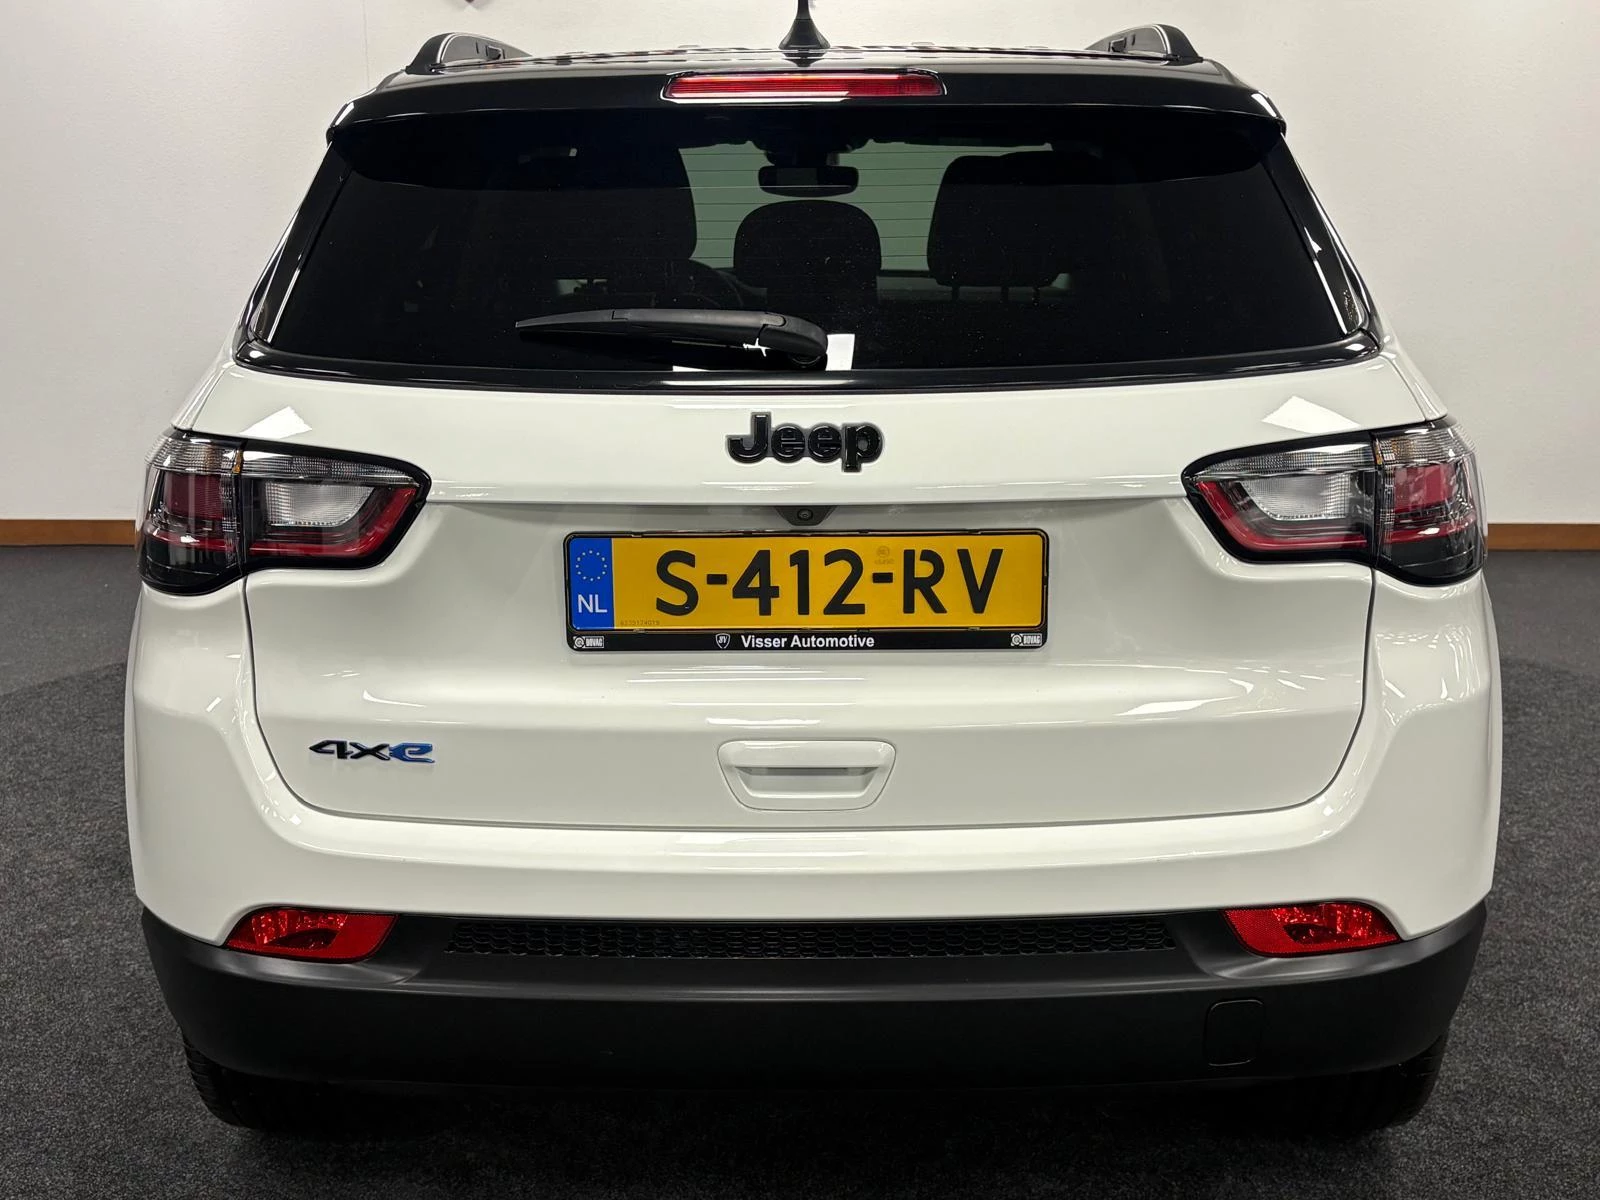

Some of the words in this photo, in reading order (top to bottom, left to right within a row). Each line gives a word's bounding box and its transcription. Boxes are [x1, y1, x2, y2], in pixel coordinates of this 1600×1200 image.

[726, 412, 884, 472] Jeep
[655, 549, 1004, 616] S-412-RV
[577, 594, 608, 613] NL
[741, 635, 787, 648] Visser
[790, 635, 875, 648] Automotive
